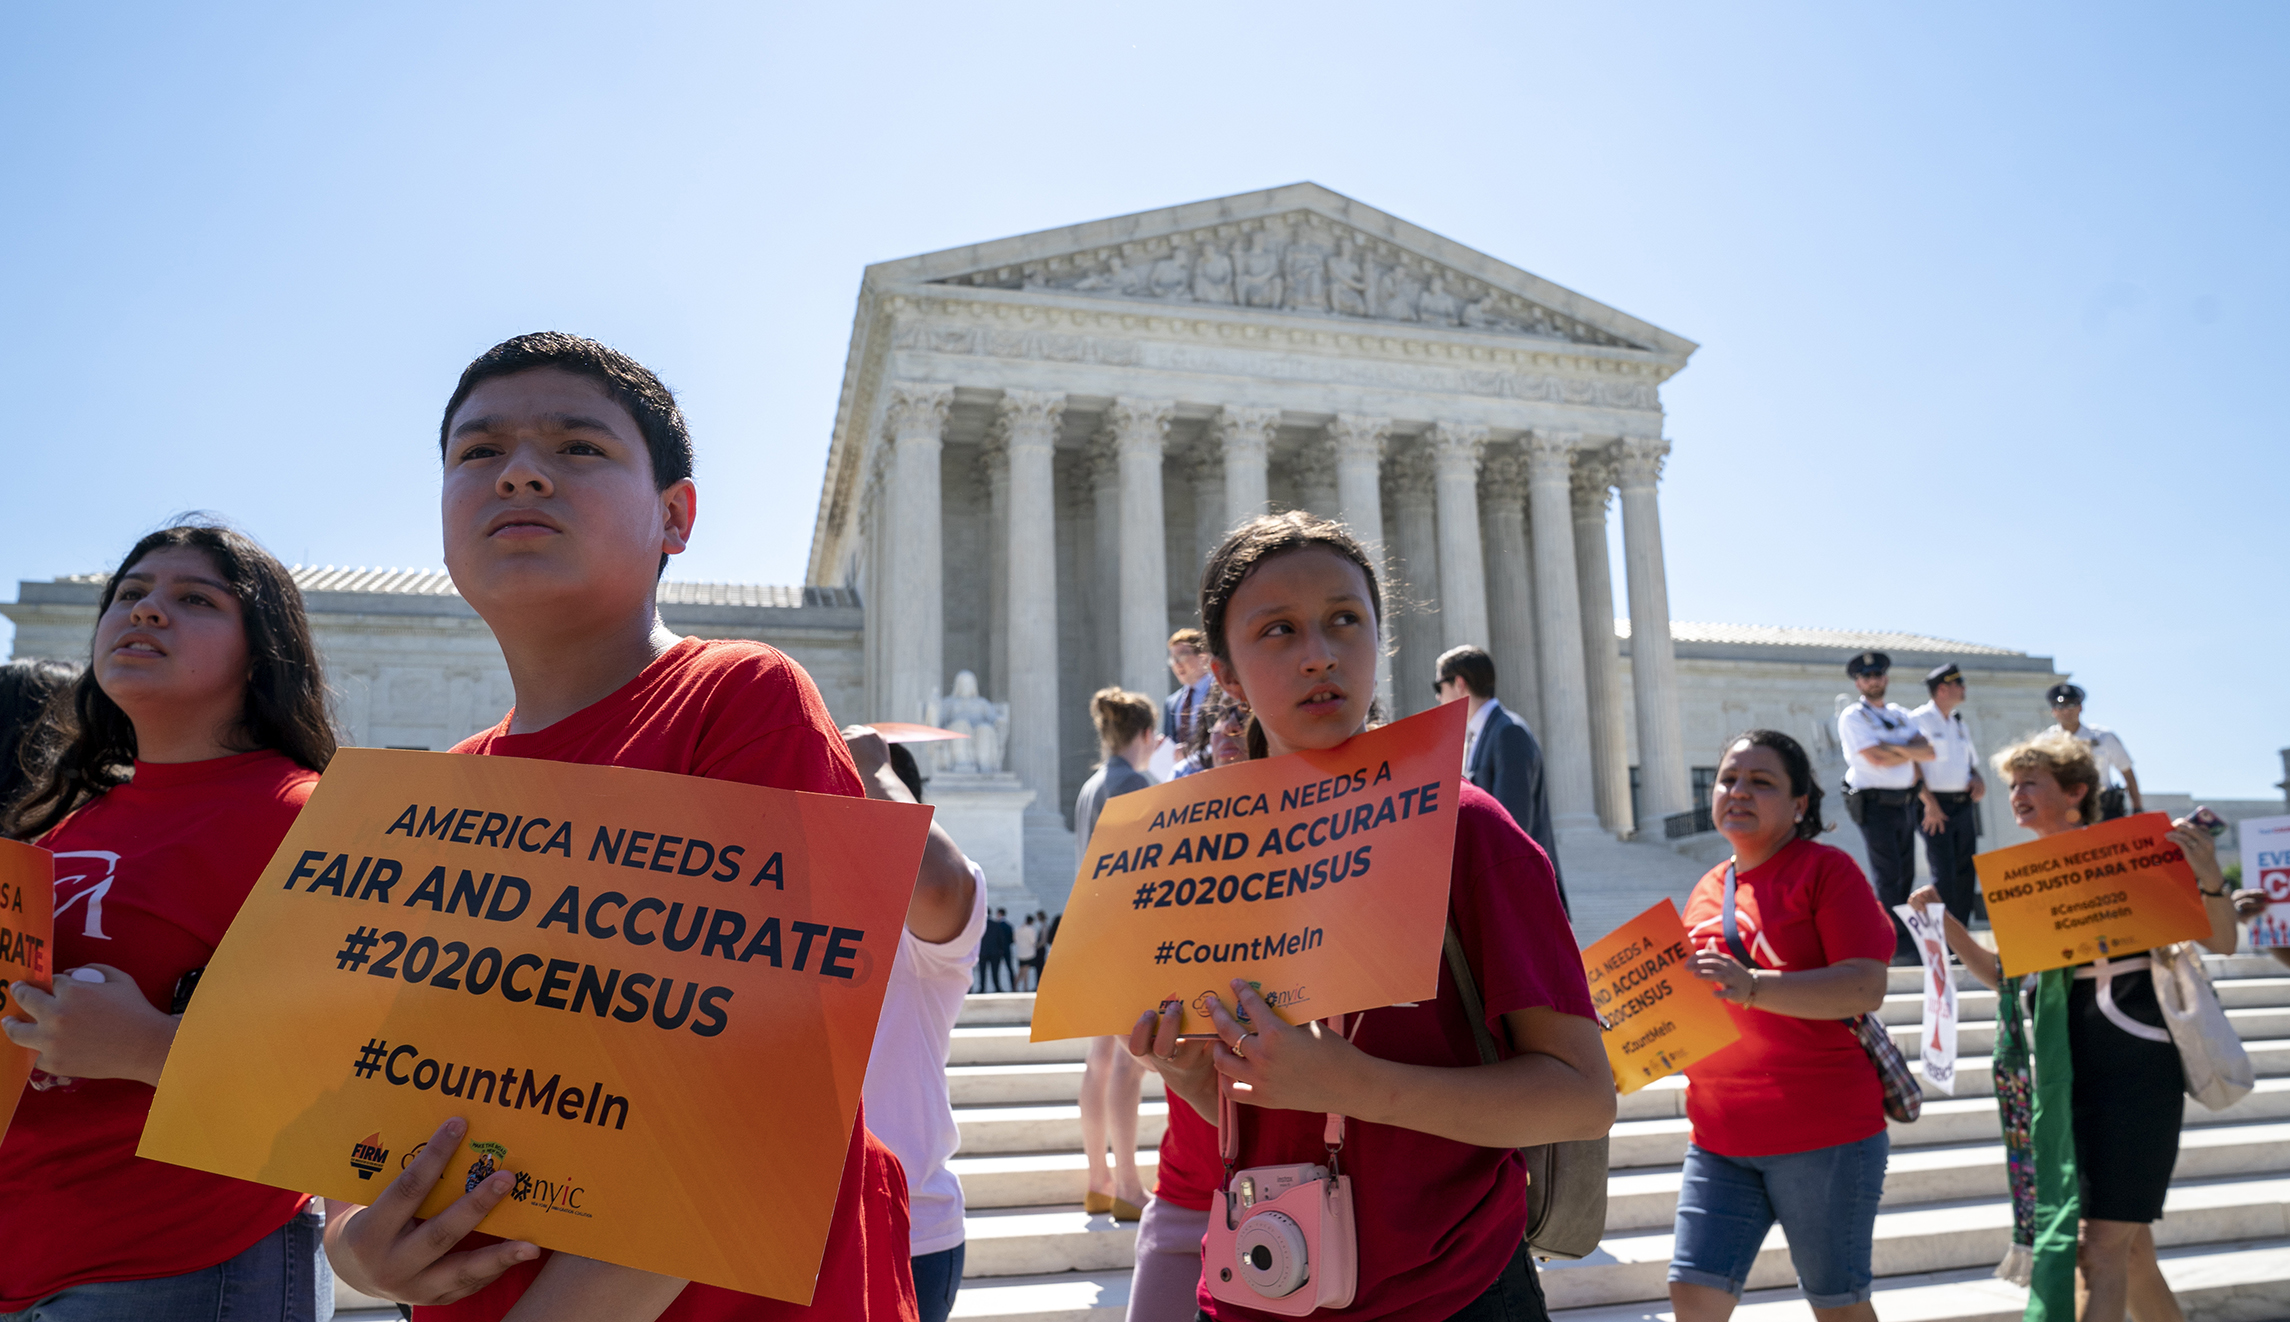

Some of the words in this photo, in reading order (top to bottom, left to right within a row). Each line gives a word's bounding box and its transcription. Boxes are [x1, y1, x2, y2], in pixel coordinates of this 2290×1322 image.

[1148, 793, 1269, 831] AMERICA
[1280, 768, 1367, 811] NEEDS
[1373, 761, 1391, 786] A
[385, 804, 571, 857] AMERICA
[588, 826, 745, 882] NEEDS
[750, 852, 784, 890] A
[1092, 843, 1163, 879] FAIR
[1168, 832, 1249, 865] AND
[1257, 781, 1440, 857] ACCURATE
[1133, 846, 1372, 909] #2020CENSUS
[1987, 883, 2033, 904] CENSO
[2036, 871, 2082, 893] JUSTO
[2084, 862, 2127, 882] PARA
[2129, 849, 2185, 871] TODOS
[2003, 858, 2061, 881] AMERICA
[2064, 842, 2129, 868] NECESITA
[2132, 837, 2155, 850] UN
[12, 887, 22, 913] A
[283, 850, 402, 903] FAIR
[403, 866, 531, 922] AND
[537, 885, 864, 979] ACCURATE
[2050, 891, 2128, 916] #Censo2020
[2054, 906, 2133, 930] #CountMeIn
[1154, 927, 1323, 964] #CountMeIn
[1603, 942, 1641, 974] NEEDS
[1643, 936, 1653, 950] A
[1612, 941, 1687, 996] ACCURATE
[336, 926, 734, 1037] #2020CENSUS
[1278, 983, 1306, 1008] nyic
[354, 1038, 628, 1130] #CountMeIn
[351, 1143, 389, 1163] FIRM
[532, 1177, 585, 1213] nyic
